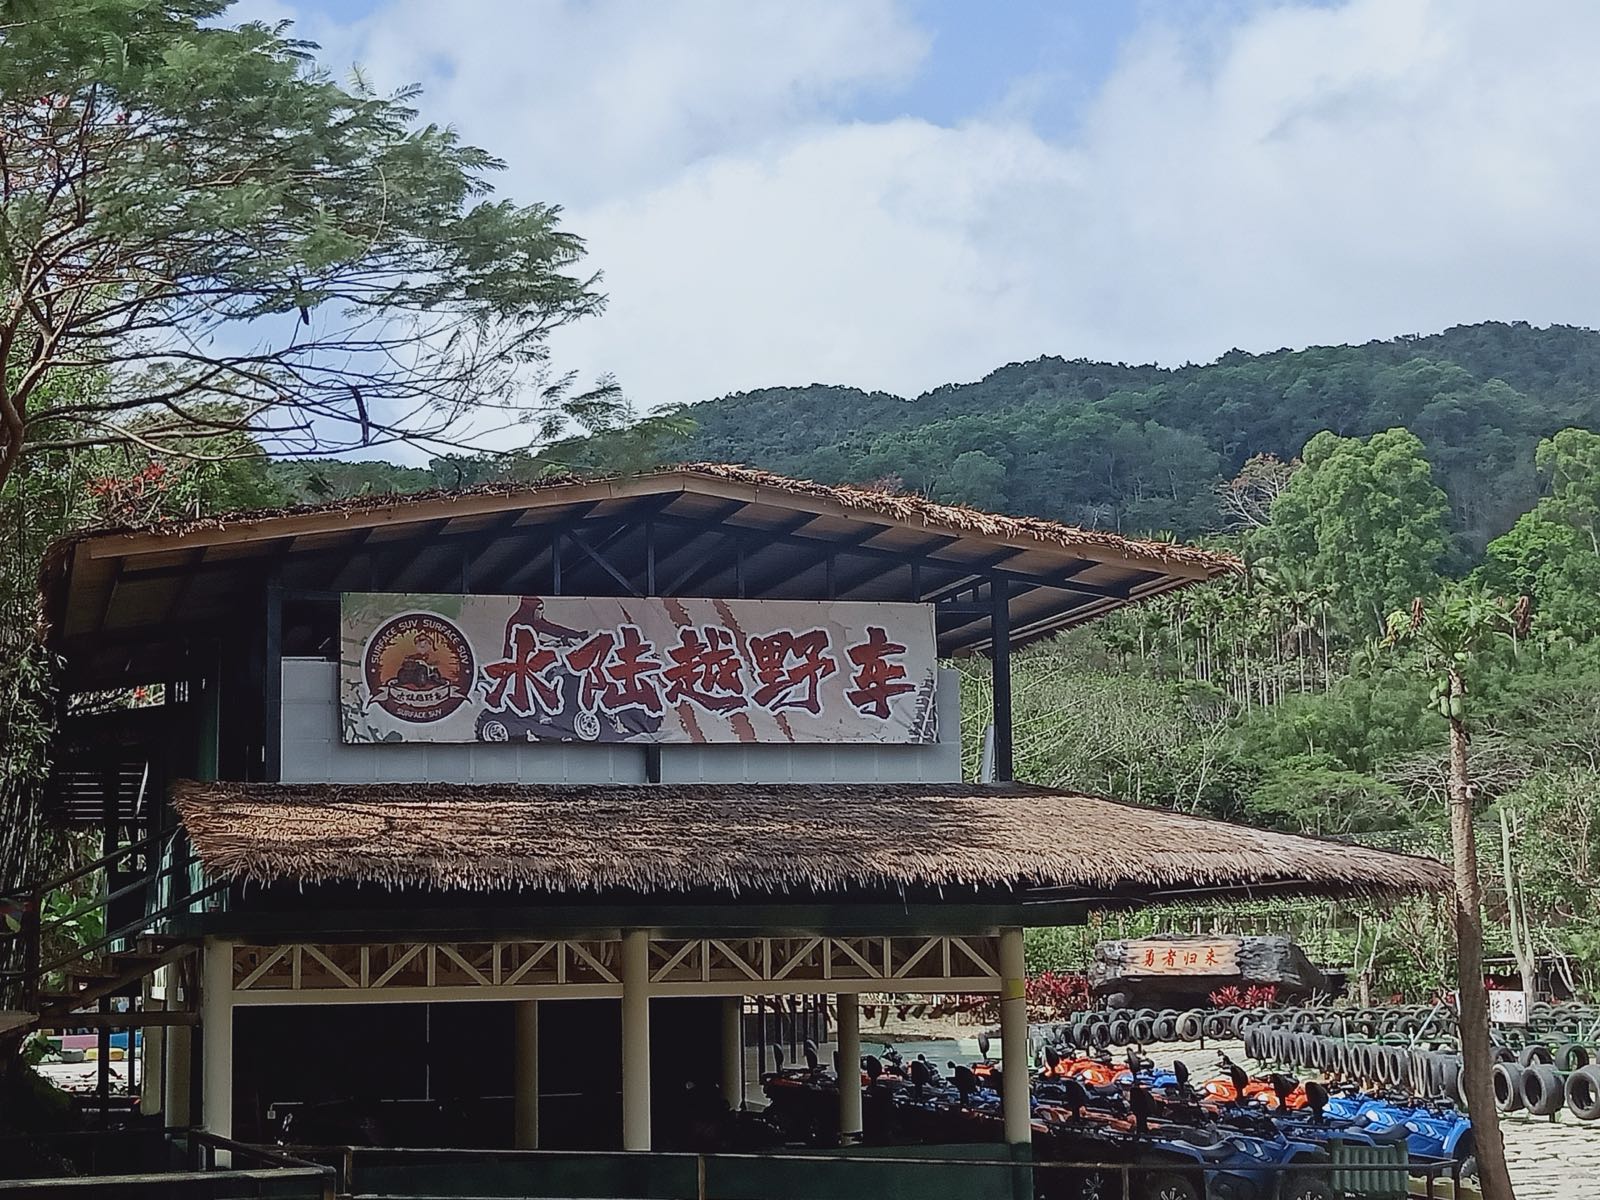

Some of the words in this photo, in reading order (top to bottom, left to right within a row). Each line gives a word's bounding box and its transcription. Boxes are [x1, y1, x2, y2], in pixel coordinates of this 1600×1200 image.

[371, 626, 398, 664] SURFACE
[398, 619, 418, 631] SUV
[423, 619, 460, 644] SURFACE
[457, 645, 469, 665] SUV
[483, 626, 916, 719] 水陆越野车
[1143, 948, 1219, 967] 勇者归来
